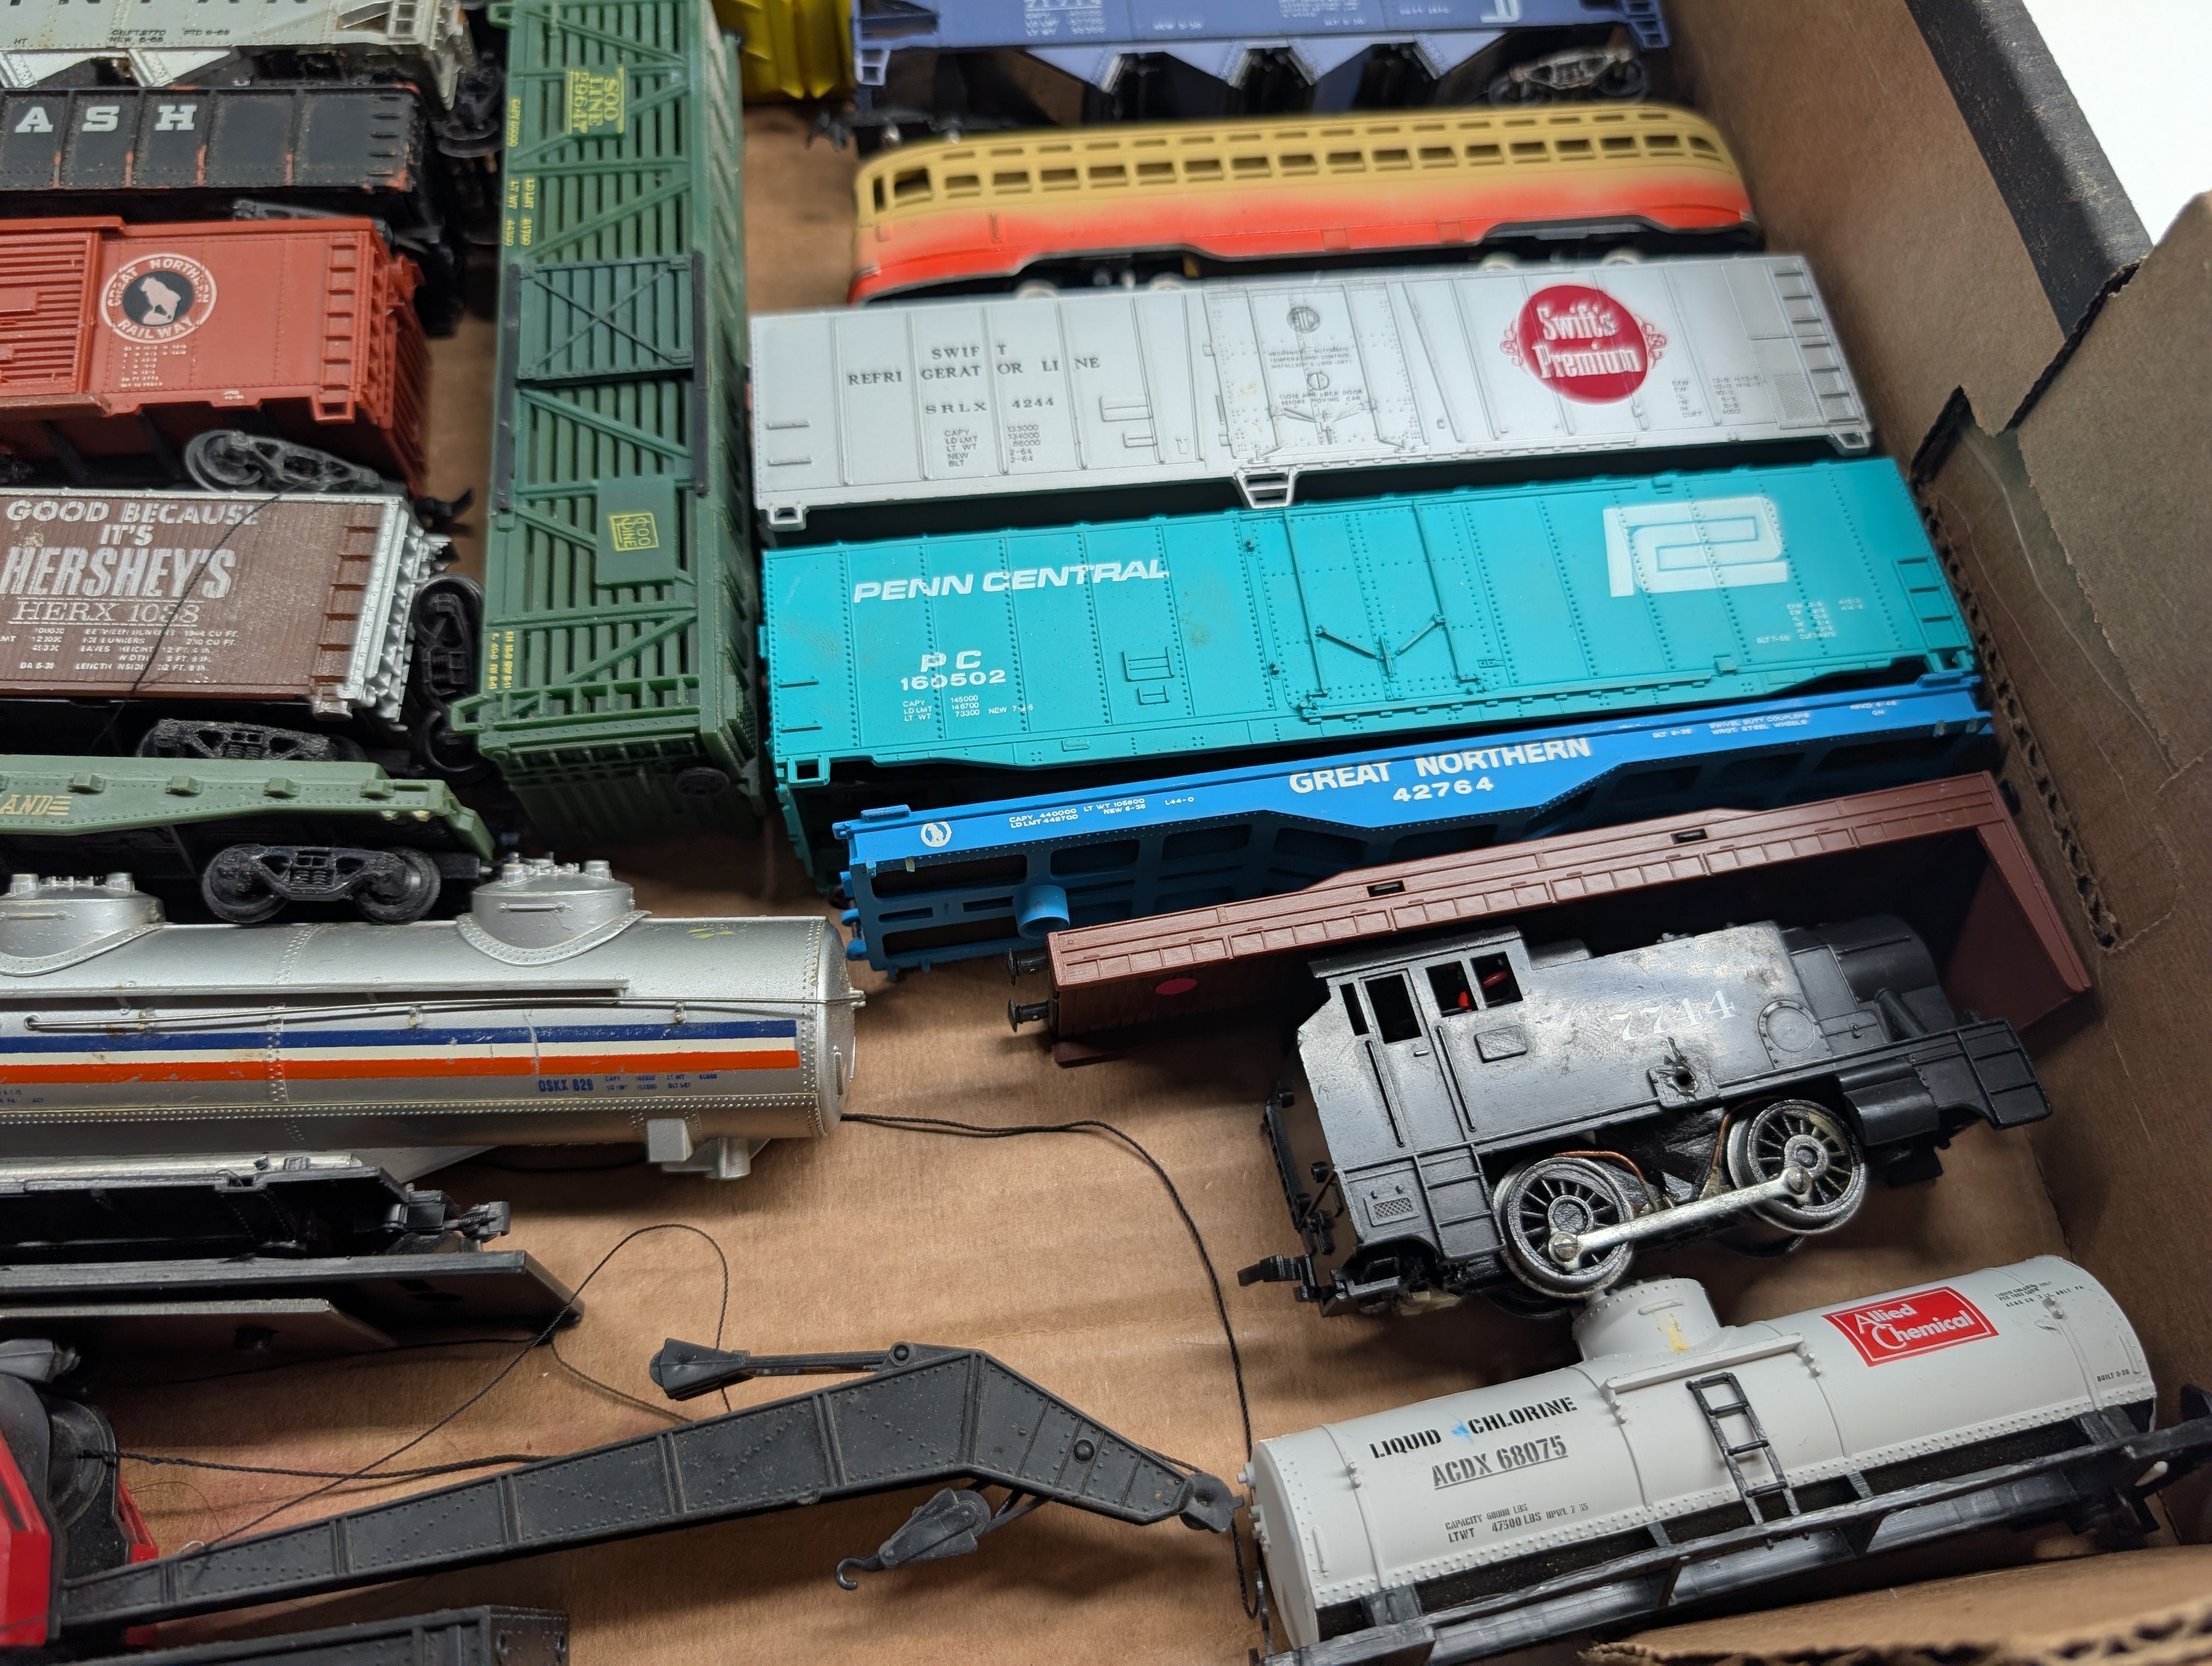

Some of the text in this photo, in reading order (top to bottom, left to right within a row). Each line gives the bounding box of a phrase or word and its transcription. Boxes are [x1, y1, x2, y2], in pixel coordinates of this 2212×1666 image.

[588, 76, 604, 126] LINE
[603, 79, 619, 121] SOO
[117, 316, 194, 339] RAILWAY
[1532, 342, 1643, 379] Premium
[925, 398, 1054, 415] SRLX 4244
[944, 429, 969, 437] CAPY
[948, 452, 969, 460] NEW
[948, 459, 964, 467] BLT
[7, 499, 109, 522] GOOD
[99, 524, 154, 546] IT'S
[0, 547, 237, 599] HERSHEY'S
[853, 559, 1170, 604] PENN CENTRAL
[12, 601, 120, 621] HERX
[900, 669, 1006, 691] 160502
[903, 695, 979, 708] CAPY 145000
[916, 706, 933, 714] LMT
[951, 702, 979, 710] 146700
[955, 709, 980, 717] 73300
[988, 706, 1007, 714] NEW
[1708, 712, 1811, 729] SWIVEL BUTT COUPLERS
[1740, 724, 1769, 732] STEEL
[1772, 719, 1809, 728] WHEELS
[1288, 736, 1592, 794] GREAT NORTHERN
[1392, 776, 1495, 803] 42764
[0, 794, 54, 816] AND
[1009, 815, 1033, 823] CAPY
[1039, 808, 1077, 819] 440000
[1096, 802, 1110, 810] WT
[1024, 819, 1041, 827] LMT
[1103, 807, 1123, 815] NEW
[1609, 990, 1736, 1041] 7744
[1994, 1290, 2013, 1298] LIQUID
[1854, 1303, 1918, 1334] Allied
[1871, 1310, 1975, 1350] Chemical
[2097, 1372, 2113, 1382] BUILT
[1368, 1396, 1578, 1459] LIQUID CHLORINE
[1431, 1434, 1567, 1487] ACDX 68075
[1445, 1514, 1483, 1530] CAPACITY
[1513, 1503, 1529, 1514] LBS
[1524, 1511, 1542, 1524] LBS
